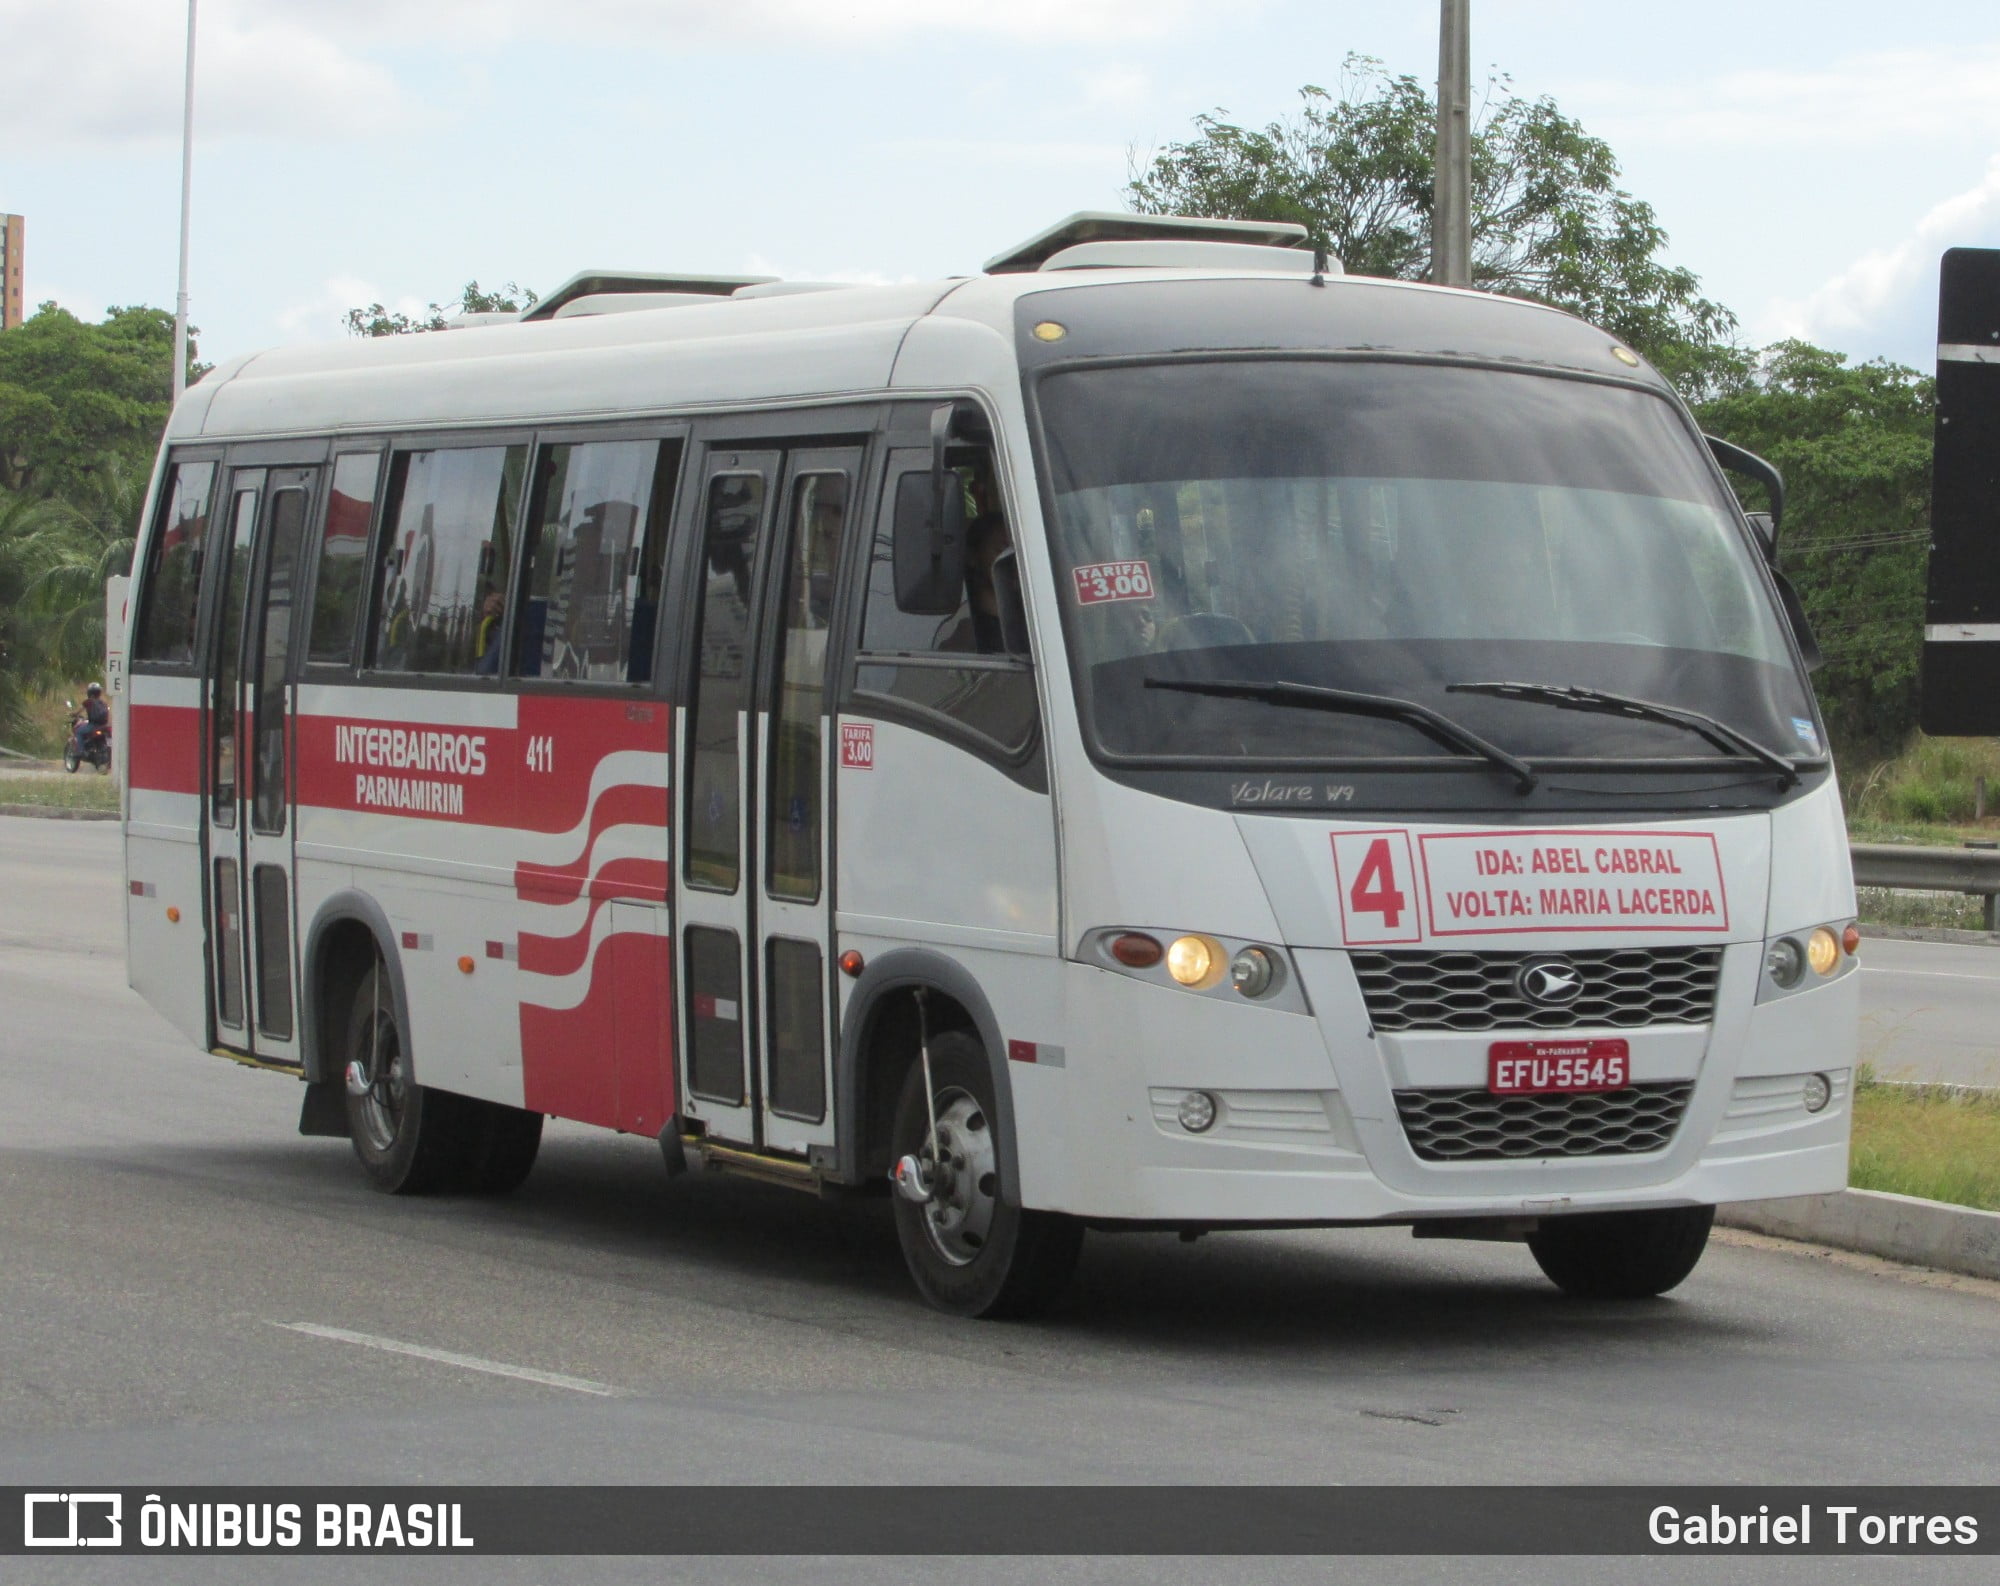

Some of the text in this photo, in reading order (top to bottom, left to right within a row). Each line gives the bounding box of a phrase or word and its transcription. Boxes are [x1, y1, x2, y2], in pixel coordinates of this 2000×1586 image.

[1079, 564, 1144, 579] TARIFA
[1092, 575, 1148, 598] 3,00
[844, 728, 871, 740] TARIFA
[335, 724, 486, 775] INTERBAIRROS
[526, 735, 553, 772] 411
[356, 774, 463, 815] PARNAMIRIM
[1231, 780, 1313, 805] Volare
[1475, 847, 1682, 875] IDA: ABEL CABRAL
[1350, 838, 1405, 928] 4
[1446, 888, 1716, 918] VOLTA: MARIA LACERDA
